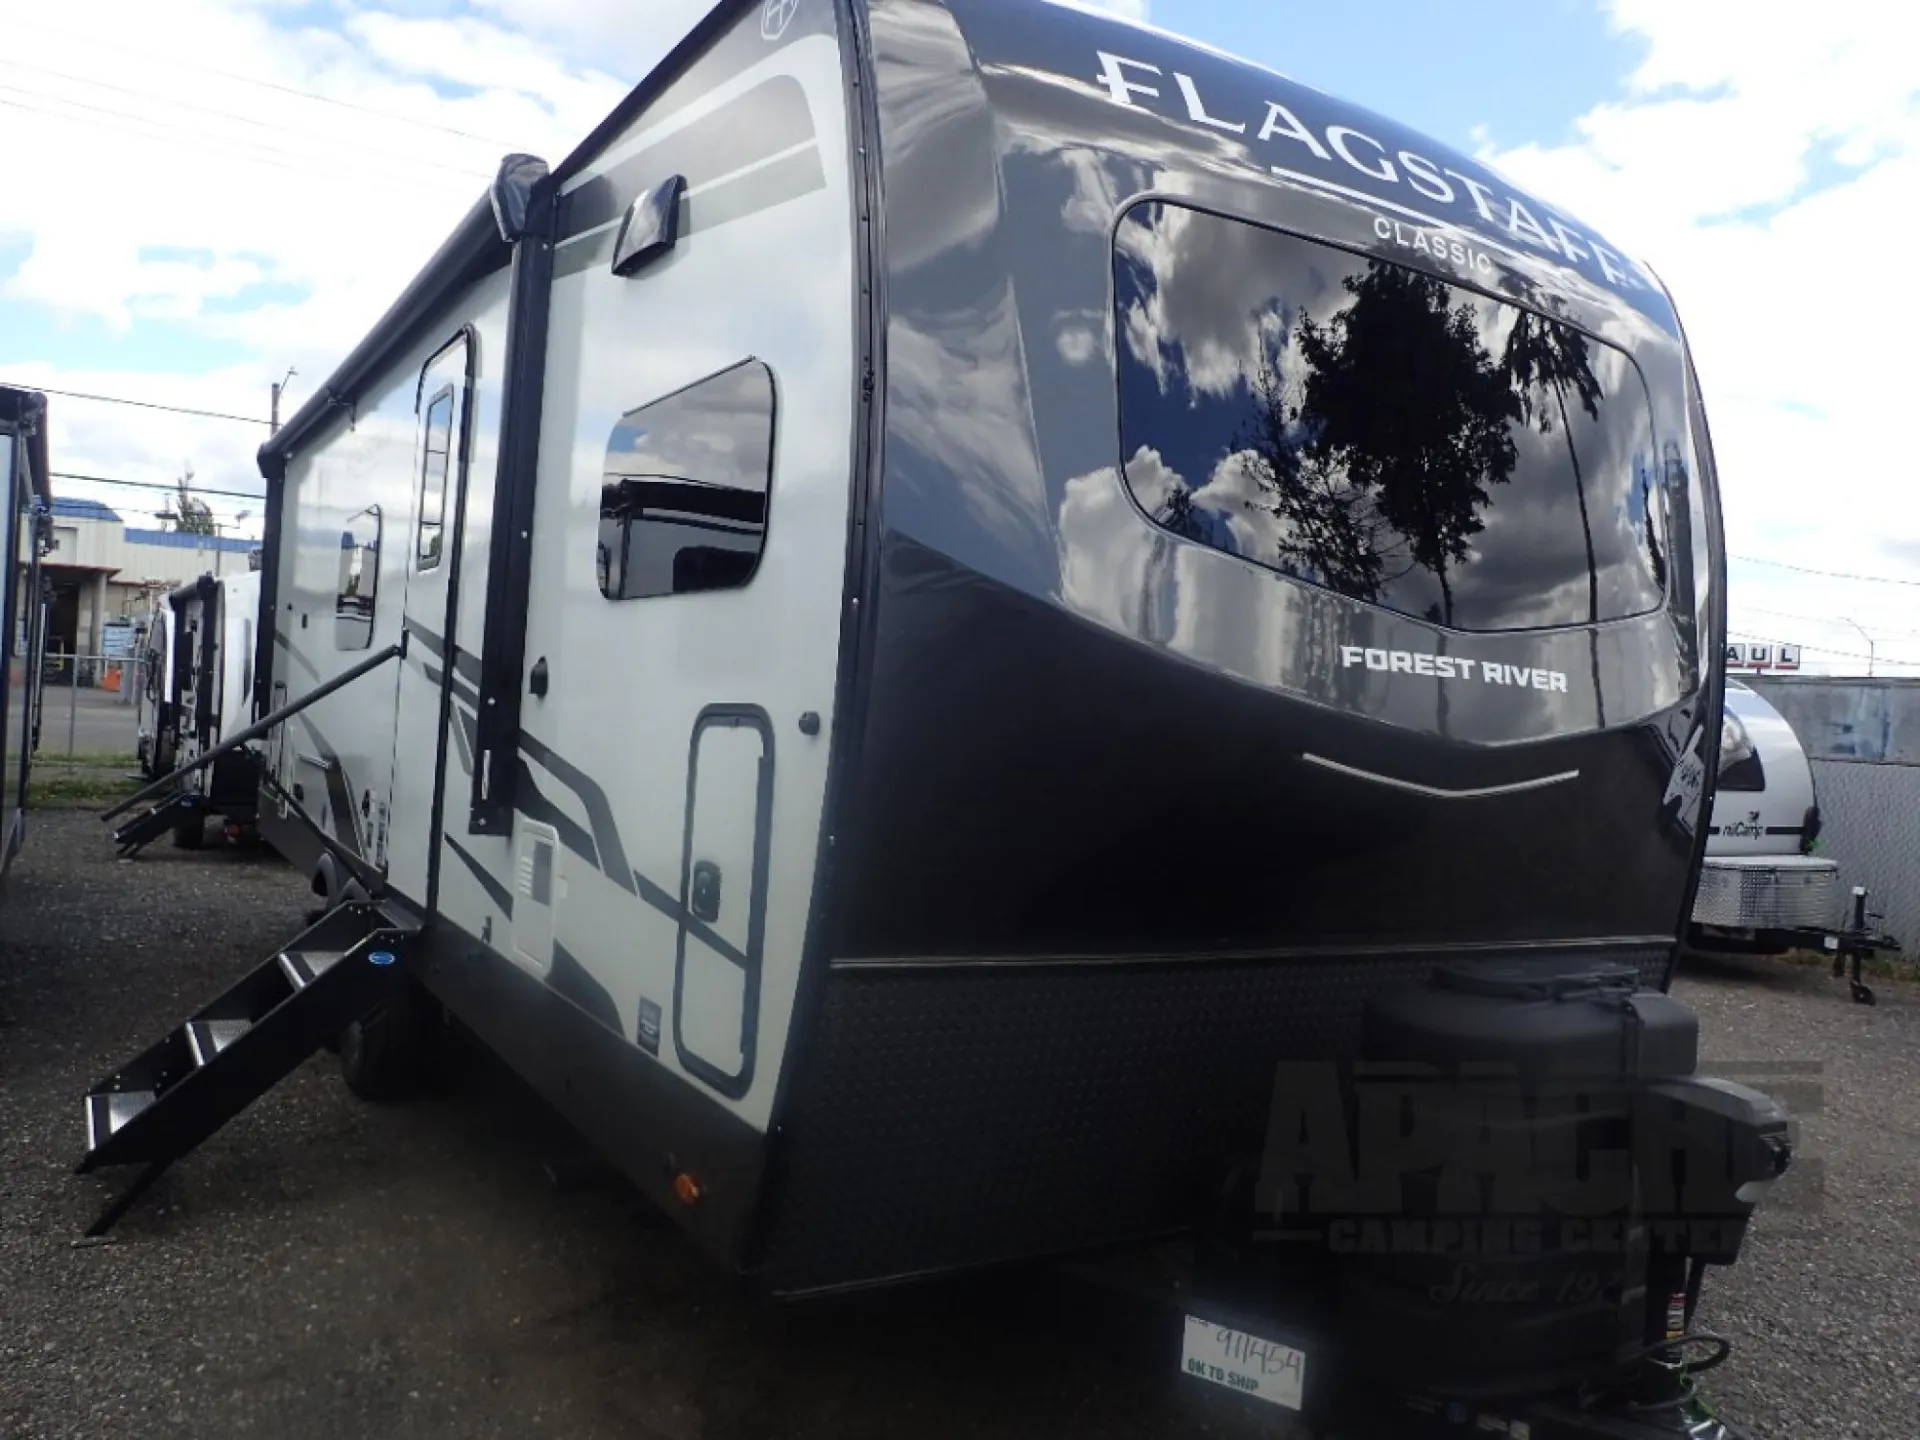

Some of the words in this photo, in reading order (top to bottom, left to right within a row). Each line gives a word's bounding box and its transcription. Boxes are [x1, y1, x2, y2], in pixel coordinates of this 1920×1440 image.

[1096, 50, 1627, 284] FLAGSTAFF
[1374, 217, 1491, 274] CLASSIC
[1340, 645, 1476, 680] FOREST
[1481, 661, 1568, 693] RIVER
[1188, 1357, 1206, 1376] OK
[1208, 1365, 1225, 1381] TO
[1227, 1370, 1259, 1392] SHIP
